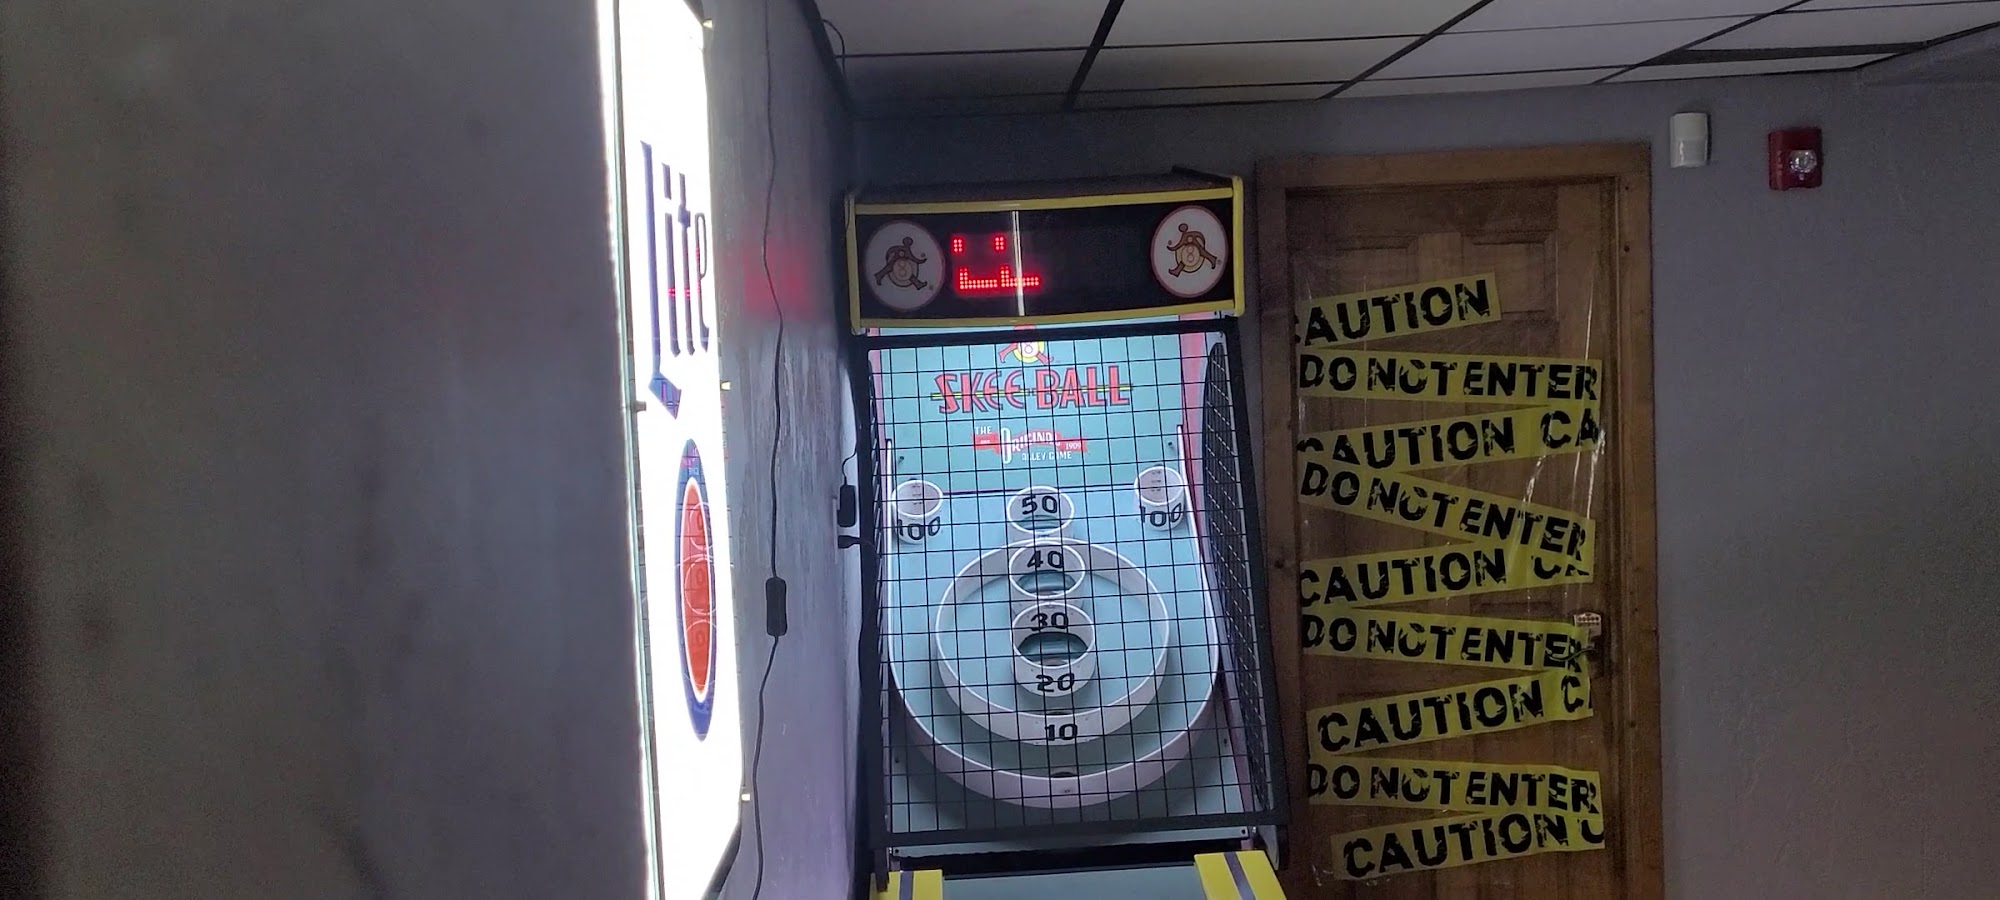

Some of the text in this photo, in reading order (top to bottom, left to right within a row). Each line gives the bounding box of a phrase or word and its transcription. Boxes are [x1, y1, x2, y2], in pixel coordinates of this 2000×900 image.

[640, 140, 710, 419] Lite
[1295, 279, 1491, 346] AUTION
[934, 365, 1131, 414] SKEE BALL
[1300, 354, 1357, 391] DO
[1463, 361, 1598, 400] ENTER
[974, 426, 992, 435] THE
[1021, 495, 1059, 515] 50
[1139, 502, 1182, 527] 100
[1300, 461, 1360, 506] DO
[1460, 498, 1586, 561] ENTER
[898, 516, 941, 541] 100
[1027, 550, 1065, 569] 40
[1300, 548, 1507, 607] CAUTION
[1030, 612, 1069, 631] 30
[1301, 614, 1357, 652] DO
[1036, 673, 1075, 692] 20
[1045, 723, 1078, 741] 10
[1317, 680, 1544, 752] CAUTION
[1306, 763, 1360, 799] DO
[1466, 771, 1600, 814] ENTER
[1343, 813, 1569, 878] CAUTION
